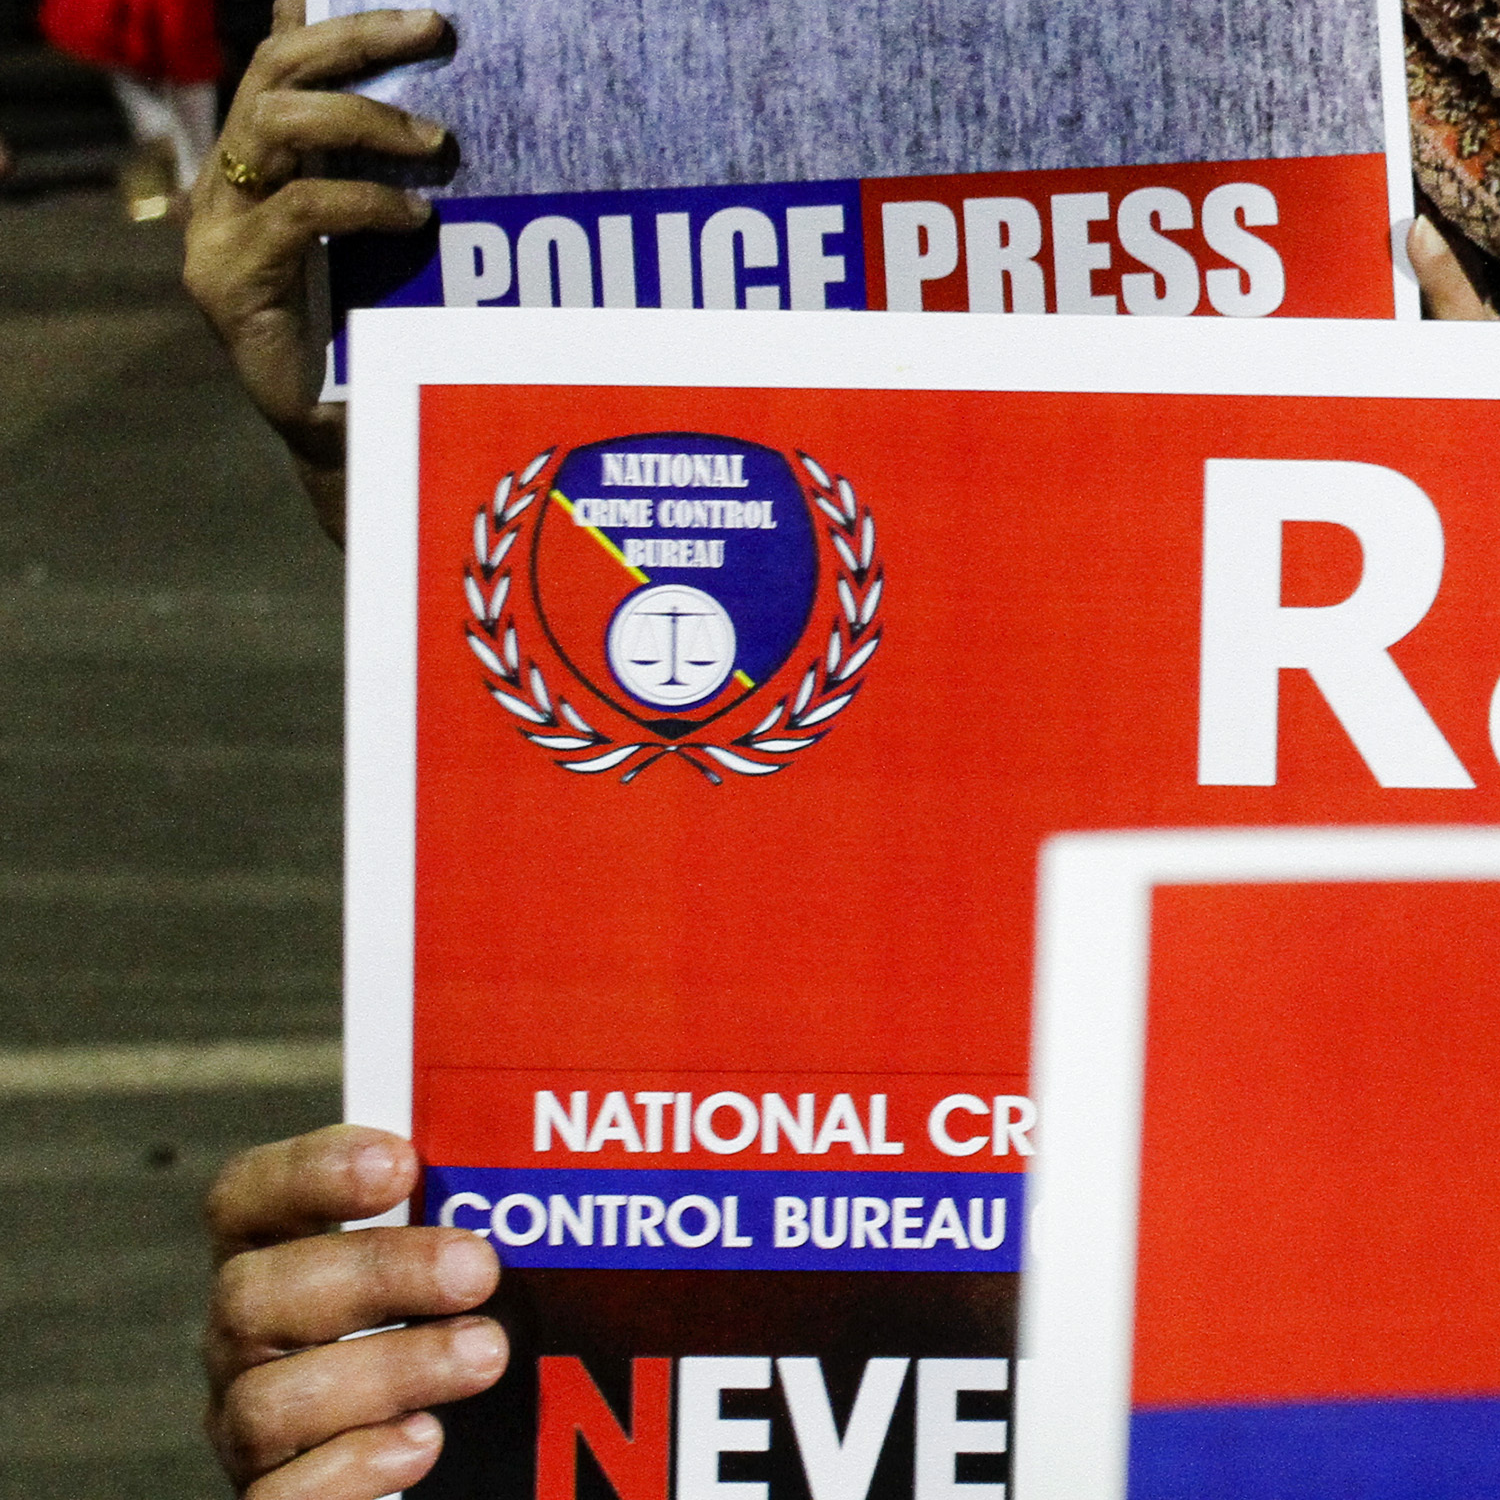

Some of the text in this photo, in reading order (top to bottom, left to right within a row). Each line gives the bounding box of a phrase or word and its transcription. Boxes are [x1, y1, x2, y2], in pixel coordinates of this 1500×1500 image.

[438, 182, 1286, 318] POLICE PRESS
[601, 453, 749, 488] NATIONAL
[573, 498, 777, 530] CRIME CONTROL
[624, 538, 726, 568] BUREAU
[533, 1090, 903, 1155] NATIONAL
[439, 1192, 753, 1248] CONTROL
[773, 1196, 1007, 1251] BUREAU
[535, 1356, 1034, 1500] NEVE
